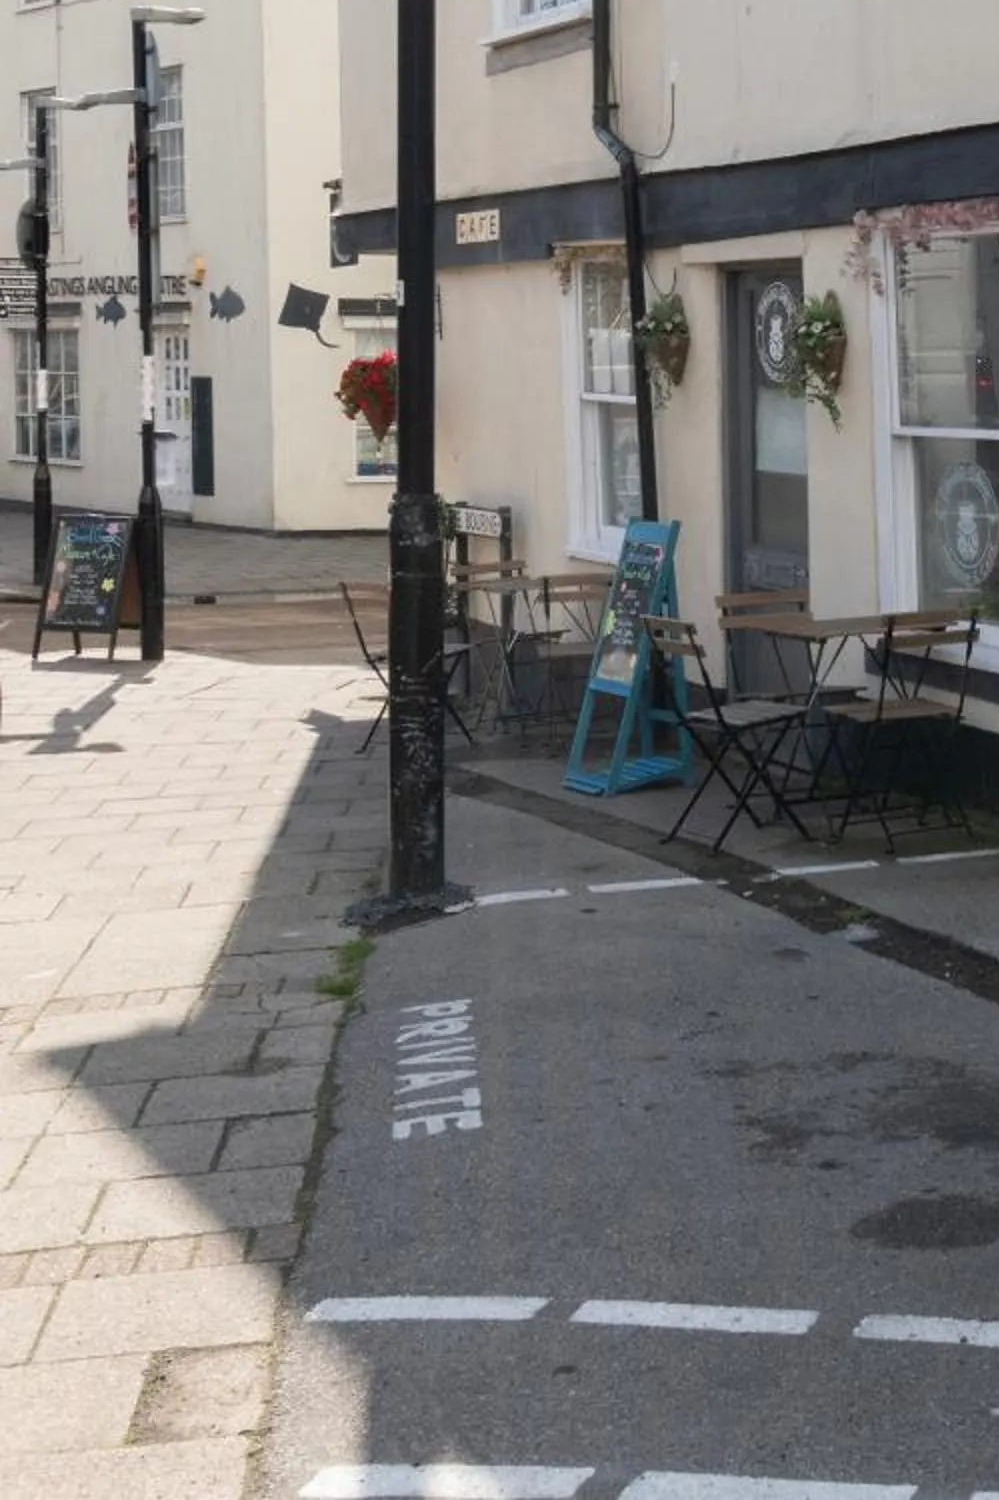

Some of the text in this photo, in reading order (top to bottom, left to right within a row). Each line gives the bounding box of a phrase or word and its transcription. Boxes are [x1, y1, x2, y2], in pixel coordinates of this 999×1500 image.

[459, 214, 497, 239] CAFE
[87, 274, 138, 296] ANGLING
[392, 998, 483, 1139] PRIVATE
